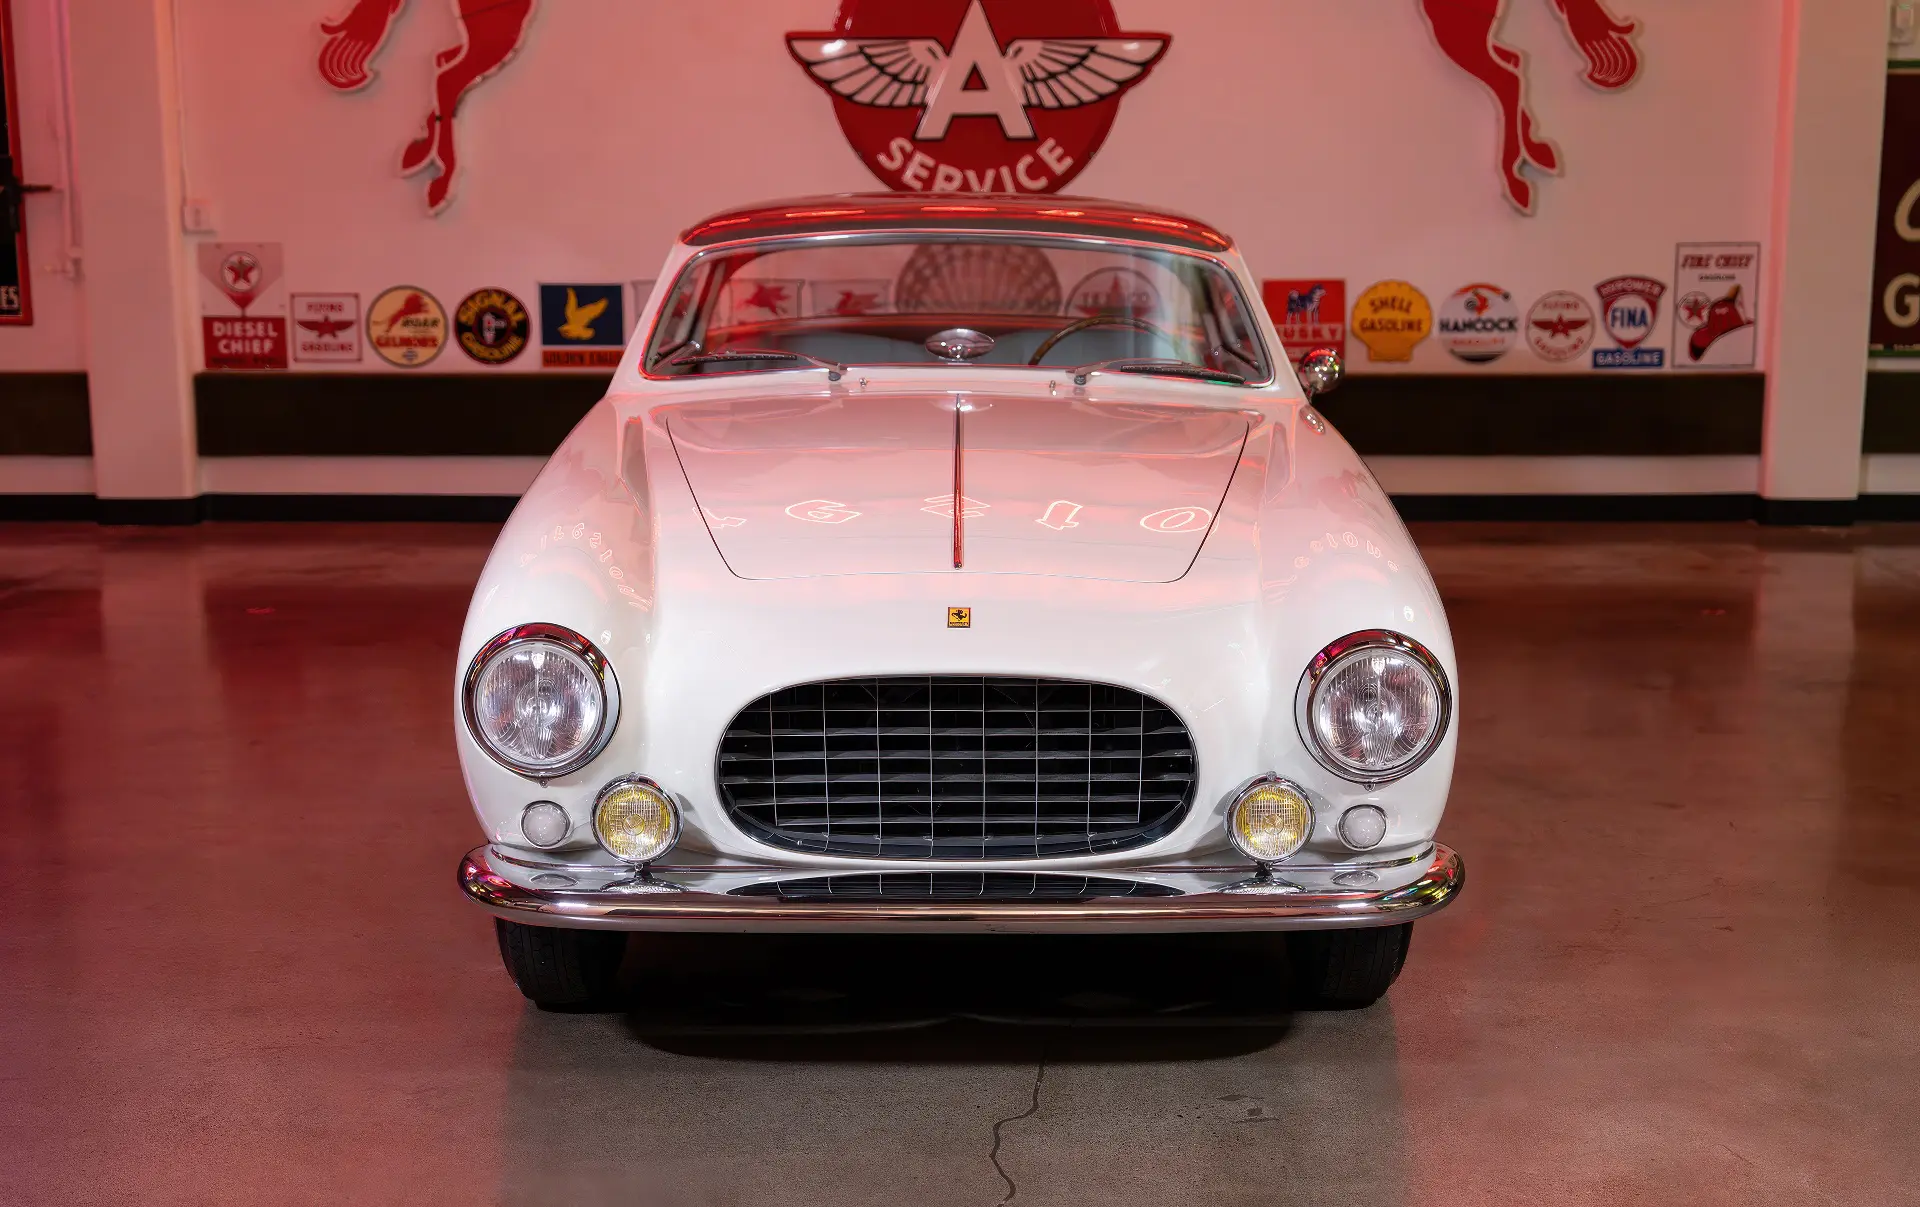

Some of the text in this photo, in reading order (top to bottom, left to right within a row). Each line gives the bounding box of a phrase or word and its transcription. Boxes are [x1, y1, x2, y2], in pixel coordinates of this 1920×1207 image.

[877, 137, 1074, 193] SERVICE
[1682, 254, 1754, 269] FIRE CHIEF
[458, 291, 525, 326] SIGNAL
[1369, 296, 1413, 314] SHELL
[1360, 317, 1424, 333] GASOLINE
[1439, 317, 1518, 333] HANCOCK
[1610, 306, 1649, 328] FINA
[212, 321, 279, 338] DIESEL
[1277, 325, 1340, 340] USKY
[217, 339, 274, 354] CHIEF
[1596, 352, 1662, 366] GASOLINE
